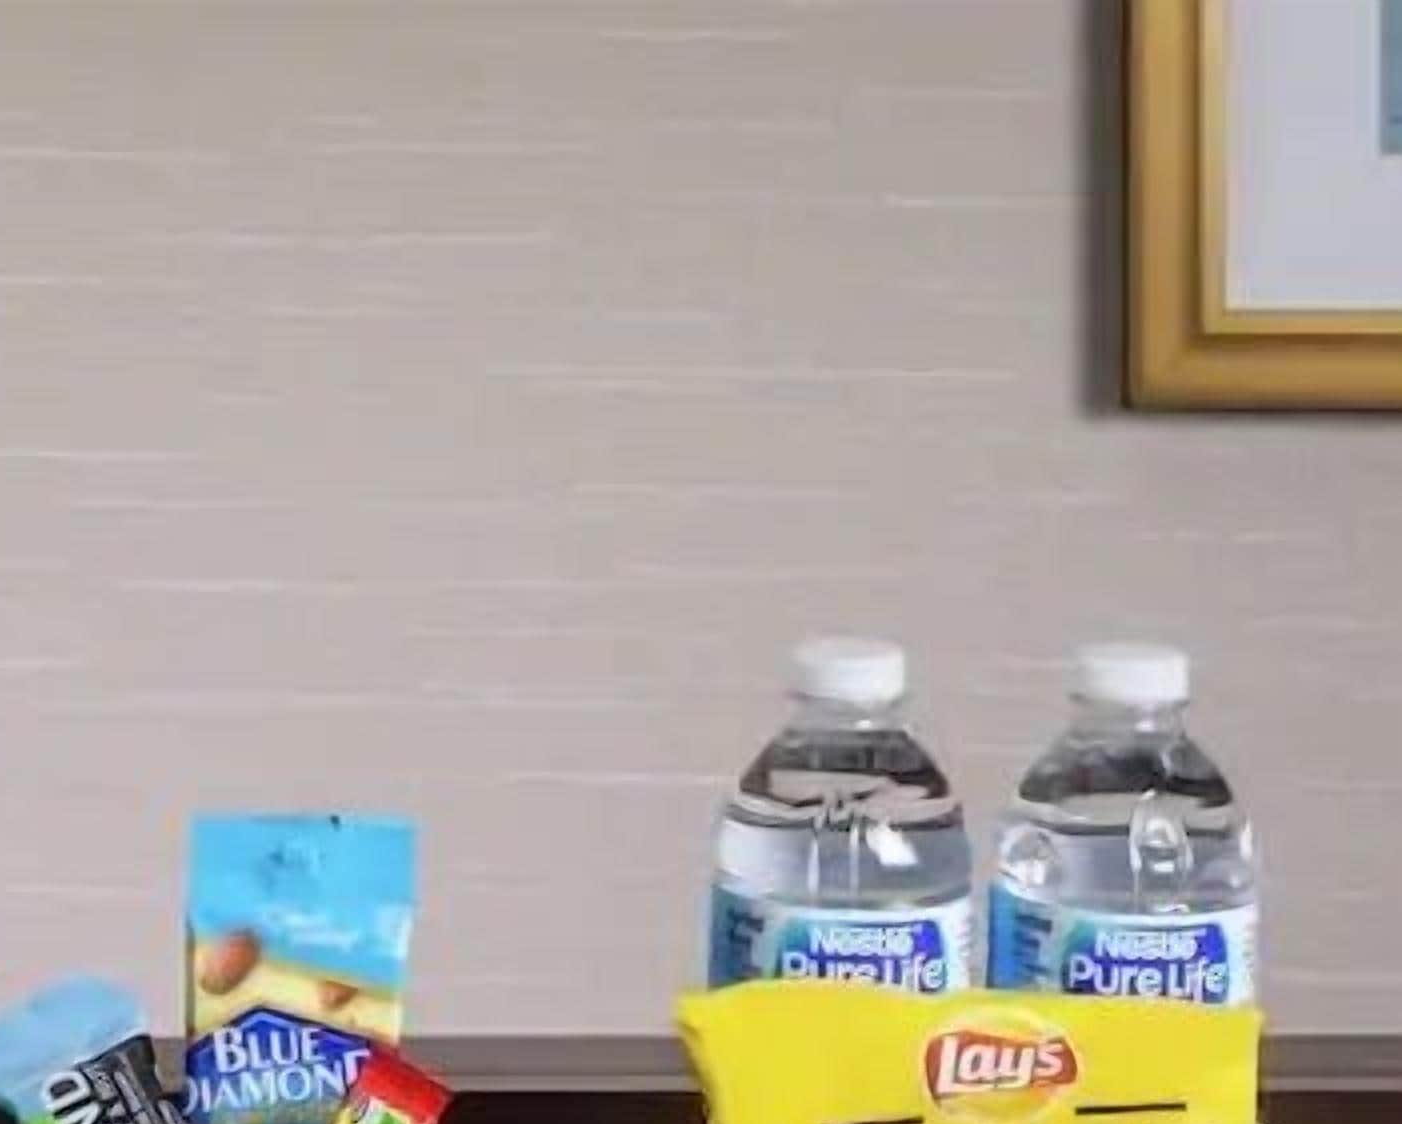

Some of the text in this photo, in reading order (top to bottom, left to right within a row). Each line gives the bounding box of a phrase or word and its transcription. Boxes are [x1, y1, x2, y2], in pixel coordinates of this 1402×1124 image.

[882, 953, 945, 991] Life
[1068, 955, 1227, 1002] Pure Life
[213, 1026, 325, 1073] BLUE
